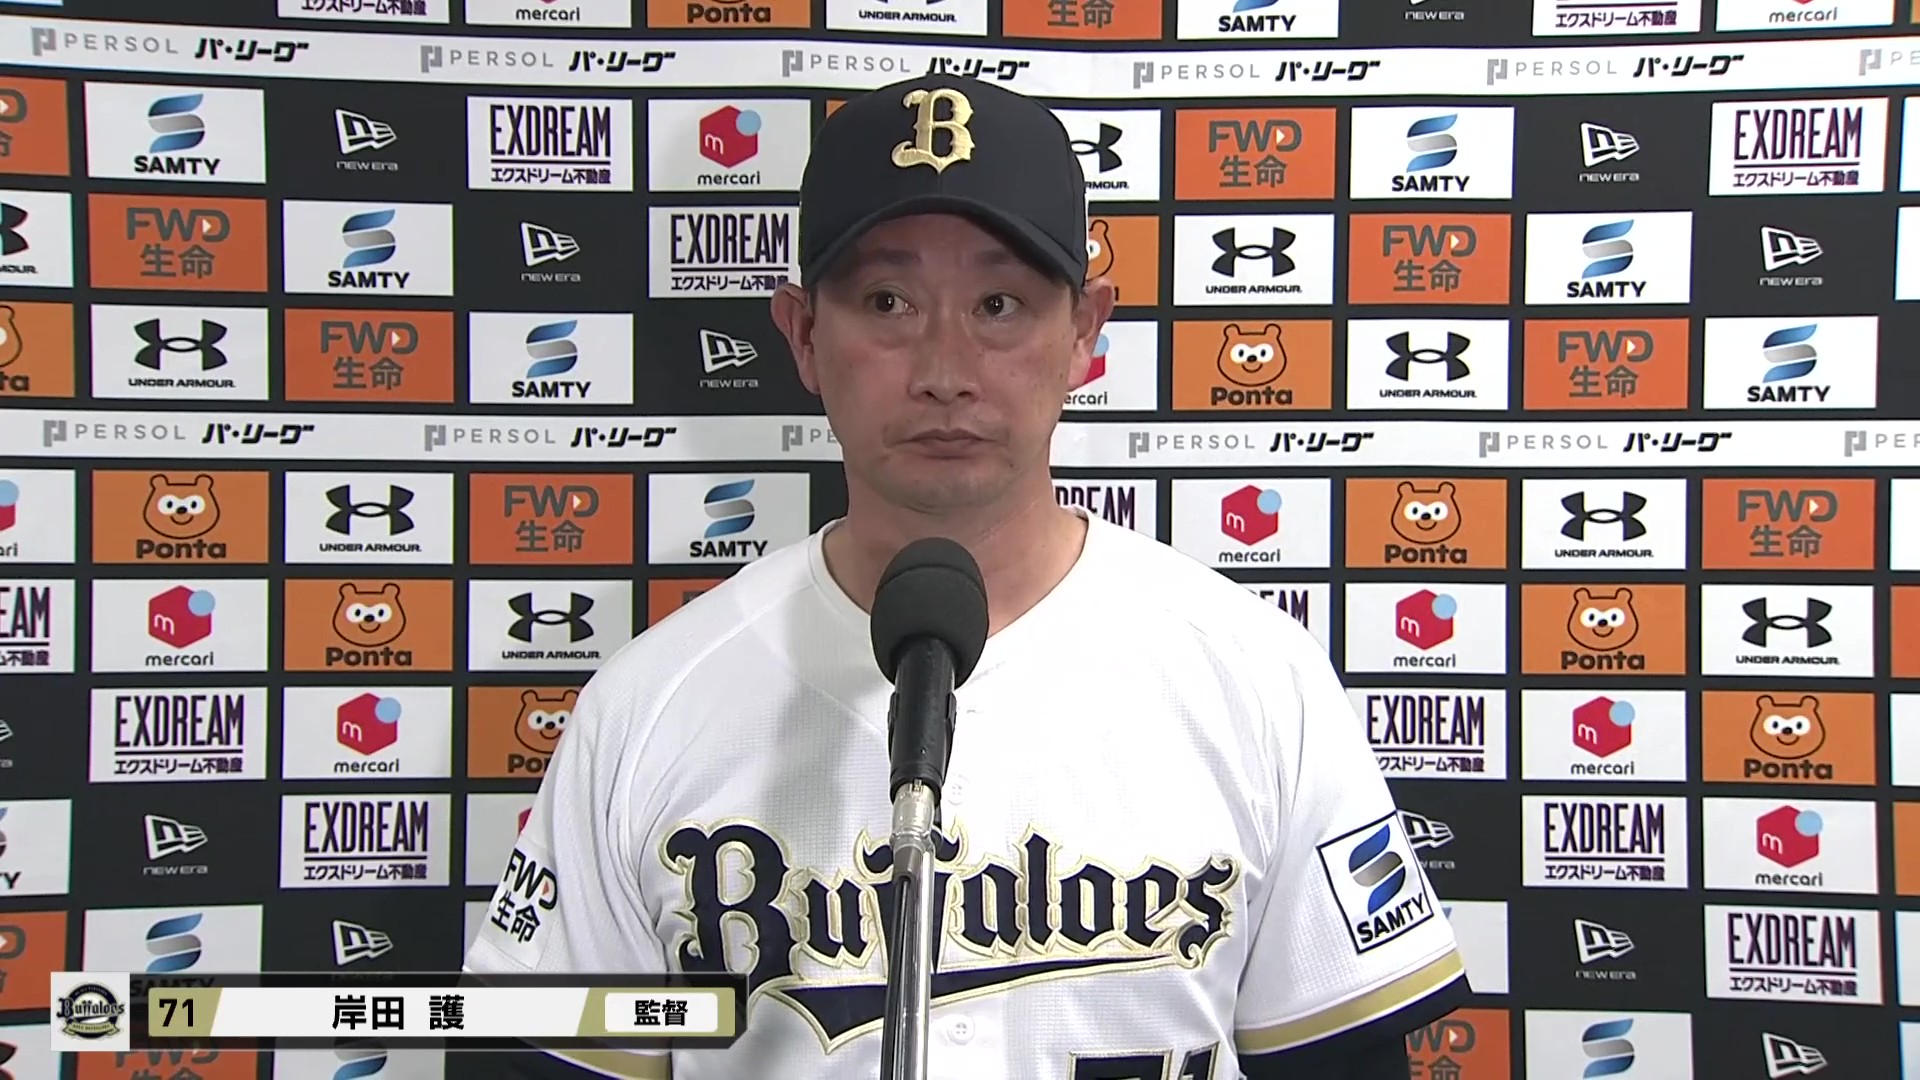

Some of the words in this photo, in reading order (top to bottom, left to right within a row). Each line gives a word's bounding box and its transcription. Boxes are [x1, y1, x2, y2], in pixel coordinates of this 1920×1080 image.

[516, 7, 580, 21] mercari
[687, 3, 771, 23] Ponta
[858, 10, 901, 21] UNDER
[1048, 0, 1114, 28] 生命
[1556, 10, 1677, 27] エクスドリーム不動産
[1769, 7, 1837, 22] mercari
[1219, 15, 1296, 32] SAMTY
[65, 33, 178, 54] PERSOL
[450, 50, 553, 67] PERSOL
[811, 54, 910, 72] PERSOL
[1162, 64, 1260, 79] PERSOL
[1516, 61, 1617, 76] PERSOL
[490, 104, 610, 157] EXDREAM
[890, 88, 975, 174] B
[1209, 120, 1302, 152] FWD
[1734, 107, 1862, 160] EXDREAM
[135, 156, 220, 175] SAMTY
[1220, 154, 1287, 188] 生命
[492, 168, 611, 184] エクスドリーム不動産
[698, 171, 760, 184] mercari
[1392, 176, 1469, 192] SAMTY
[1733, 170, 1859, 187] エクスドリーム不動産
[127, 207, 230, 242] FWD
[671, 214, 789, 264] EXDREAM
[1383, 225, 1476, 257] FWD
[140, 244, 215, 279] 生命
[328, 271, 409, 288] SAMTY
[1393, 259, 1462, 292] 生命
[1205, 285, 1247, 294] UNDER
[1567, 281, 1646, 298] SAMTY
[321, 321, 418, 354] FWD
[1558, 330, 1653, 363] FWD
[333, 356, 404, 390] 生命
[1569, 365, 1638, 398] 生命
[128, 378, 175, 387] UNDER
[512, 381, 590, 398] SAMTY
[1064, 391, 1107, 405] ercari
[1211, 386, 1292, 406] Ponta
[1379, 389, 1422, 398] UNDER
[1748, 386, 1830, 402] SAMTY
[76, 424, 185, 440] PERSOL
[454, 429, 555, 443] PERSOL
[1157, 435, 1254, 449] PERSOL
[1508, 435, 1607, 449] PERSOL
[505, 485, 599, 517] FWD
[1738, 490, 1838, 522] FWD
[516, 520, 584, 552] 生命
[1750, 525, 1822, 558] 生命
[136, 539, 226, 559] Ponta
[319, 543, 364, 552] UNDER
[690, 541, 767, 557] SAMTY
[1219, 549, 1280, 562] mercari
[1385, 544, 1467, 564] Ponta
[1554, 549, 1597, 558] UNDER
[146, 652, 213, 666] mercari
[326, 647, 412, 666] Ponta
[501, 650, 545, 660] UNDER
[1394, 654, 1455, 667] mercari
[1561, 651, 1644, 670] Ponta
[1735, 655, 1781, 665] UNDER
[115, 695, 244, 747] EXDREAM
[1367, 695, 1484, 746] EXDREAM
[114, 757, 243, 774] エクスドリーム不動産
[334, 759, 399, 772] mercari
[1377, 756, 1484, 772] クスドリーム不動産
[1571, 761, 1634, 774] mercari
[1744, 759, 1832, 779] Ponta
[304, 801, 428, 853] EXDREAM
[1544, 803, 1664, 854] EXDREAM
[304, 863, 427, 880] エクスドリーム不動産
[504, 848, 558, 910] FWD
[1545, 865, 1664, 881] エクスドリーム不動産
[1755, 873, 1822, 886] mercari
[491, 890, 540, 942] 生命
[1357, 893, 1426, 944] SAMTY
[1728, 913, 1856, 968] EXDREAM
[1730, 977, 1857, 996] エクスドリーム不動産
[1409, 1020, 1475, 1053] WD
